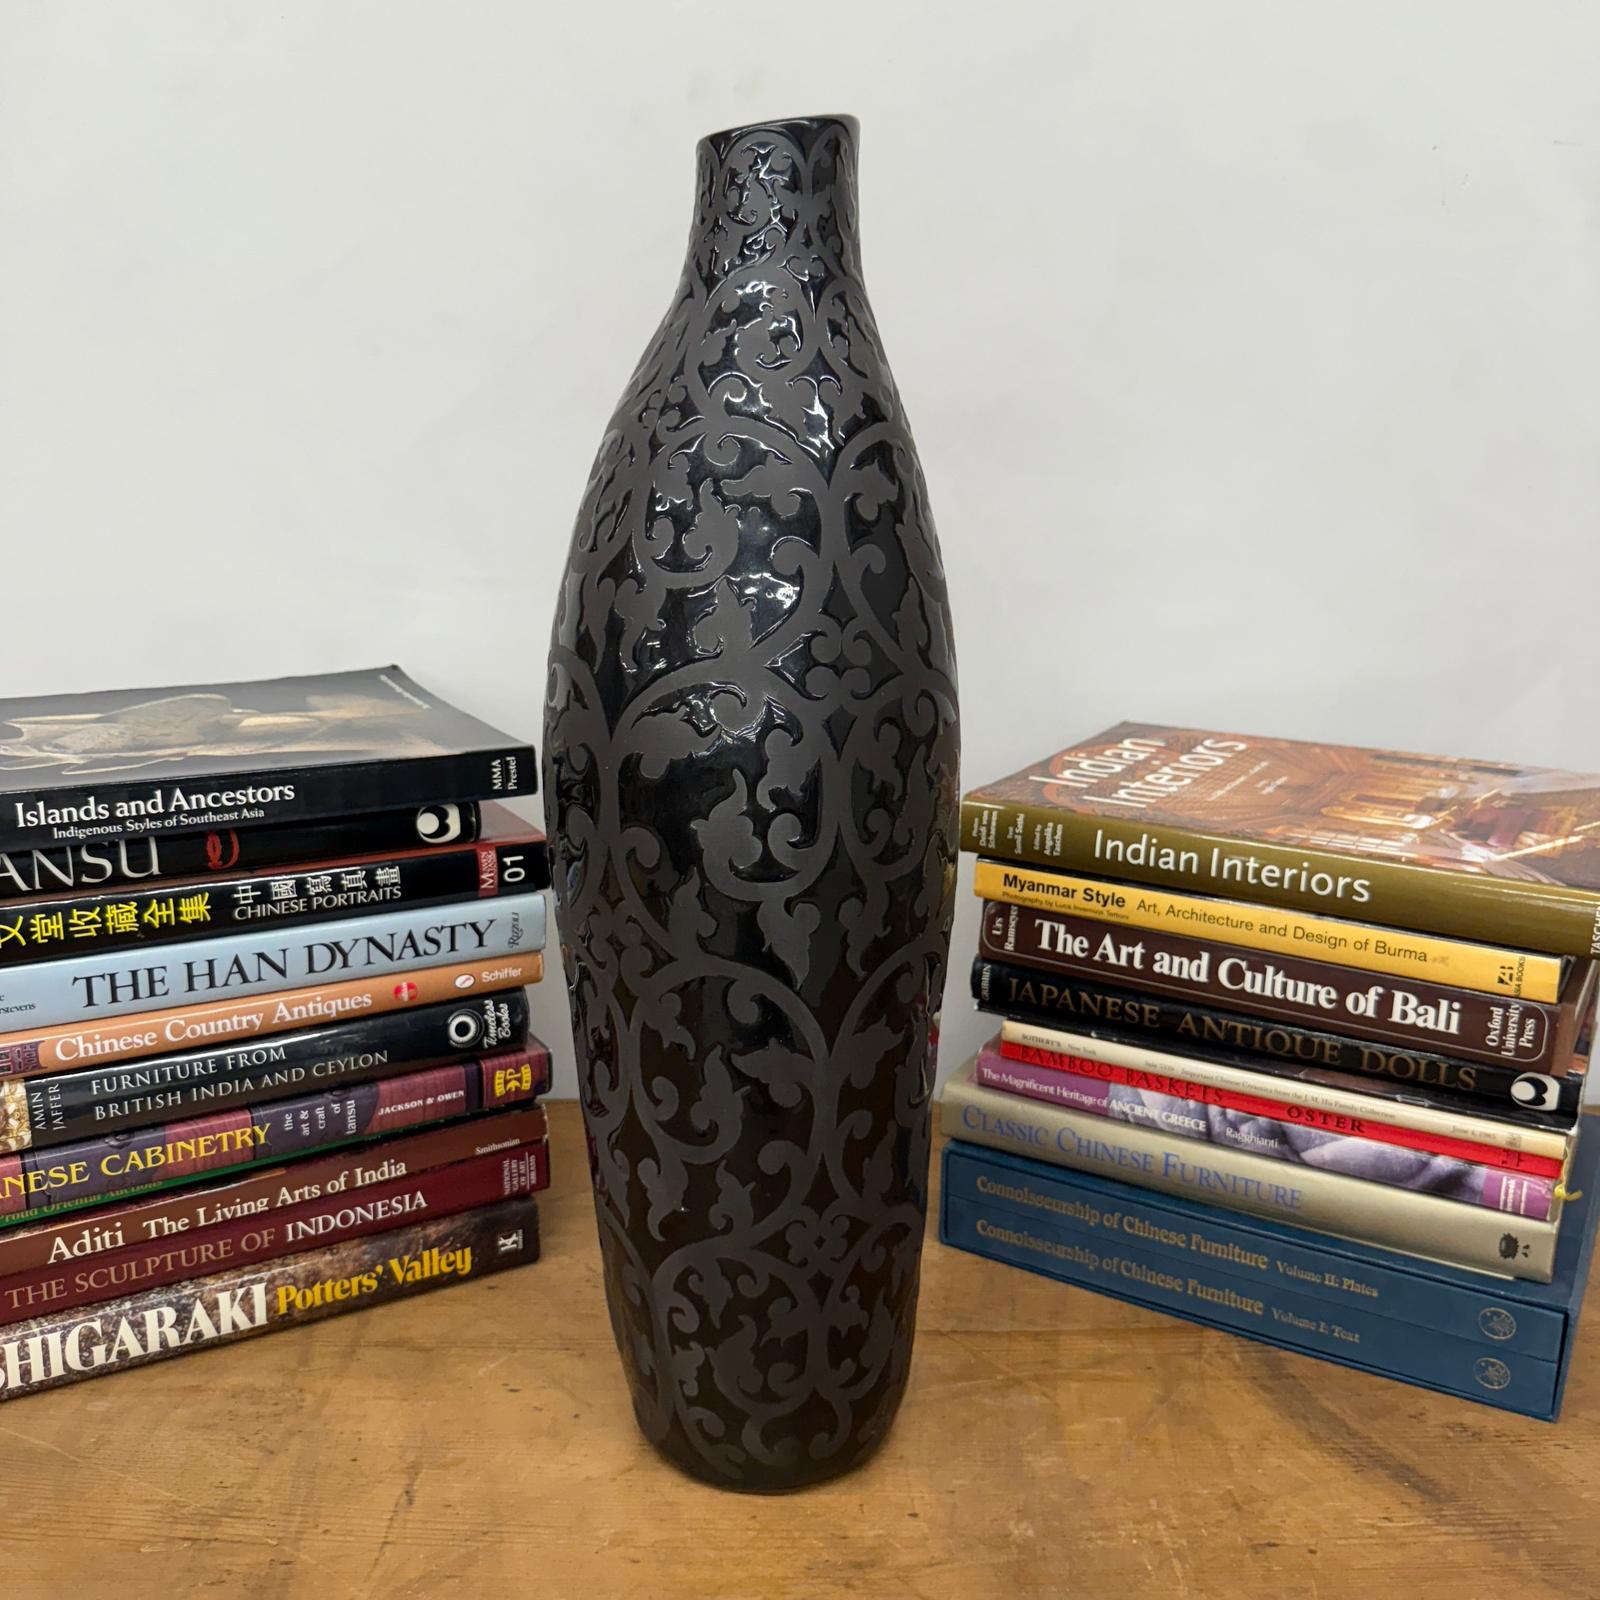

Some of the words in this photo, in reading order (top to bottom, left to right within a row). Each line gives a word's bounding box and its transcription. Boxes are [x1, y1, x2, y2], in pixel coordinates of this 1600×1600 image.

[491, 759, 503, 791] MMA
[507, 756, 518, 791] Prestel
[1028, 736, 1166, 788] Indian
[1083, 738, 1248, 808] Interiors
[15, 796, 110, 828] Islands
[115, 790, 165, 818] and
[168, 784, 295, 813] Ancestors
[53, 824, 123, 840] Indigenous
[126, 818, 163, 836] Styles
[164, 816, 179, 828] of
[180, 810, 239, 827] Southeast
[241, 807, 265, 821] Asia
[503, 855, 526, 883] 01
[1094, 829, 1199, 874] Indian
[1210, 848, 1372, 903] Interiors
[233, 898, 308, 921] CHINESE
[312, 886, 402, 911] PORTRAITS
[992, 917, 1003, 935] Urs
[1003, 873, 1077, 899] Myanmar
[1083, 887, 1126, 908] Style
[1136, 899, 1161, 916] Art,
[1165, 903, 1254, 931] Architecture
[1259, 921, 1288, 937] and
[1293, 926, 1347, 949] Design
[1353, 938, 1370, 952] of
[1374, 940, 1428, 963] Burma
[72, 965, 170, 1008] THE
[184, 948, 290, 993] HAN
[304, 919, 497, 974] DYNASTY
[482, 967, 523, 983] Schiffer
[1035, 918, 1090, 957] The
[1093, 932, 1146, 970] Art
[1153, 951, 1210, 983] and
[1218, 957, 1337, 1009] Culture
[1346, 985, 1383, 1018] of
[1388, 989, 1462, 1035] Bali
[55, 1030, 158, 1062] Chinese
[165, 1012, 264, 1043] Country
[271, 992, 373, 1024] Antiques
[497, 1003, 511, 1040] Books
[1008, 977, 1160, 1028] JAPANESE
[1178, 1012, 1342, 1065] ANTIQUE
[1359, 1047, 1477, 1090] DOLLS
[1485, 1006, 1504, 1048] Oxford
[1501, 1002, 1523, 1057] University
[1518, 1018, 1536, 1048] Press
[90, 1059, 218, 1096] FURNITURE
[226, 1046, 287, 1075] FROM
[94, 1093, 182, 1121] BRITISH
[192, 1078, 255, 1100] INDIA
[261, 1067, 305, 1088] AND
[312, 1050, 389, 1077] CEYLON
[1020, 1046, 1113, 1078] BAMBOO
[1126, 1068, 1223, 1102] BASKETS
[1287, 1105, 1365, 1134] OSTER
[31, 1092, 47, 1131] AMIN
[48, 1083, 67, 1131] JAFFER
[283, 1112, 293, 1131] the
[300, 1110, 310, 1121] &
[315, 1105, 326, 1130] craft
[331, 1102, 342, 1115] of
[378, 1098, 424, 1117] JACKSON
[427, 1096, 435, 1106] &
[437, 1090, 465, 1103] OWEN
[982, 1067, 999, 1081] The
[1001, 1070, 1054, 1096] Magnificent
[1056, 1087, 1096, 1106] Heritage
[1096, 1096, 1108, 1106] of
[1109, 1099, 1160, 1119] ANCIENT
[1161, 1112, 1207, 1132] GREECE
[1225, 1126, 1279, 1149] Ragghianti
[300, 1120, 310, 1136] art
[475, 1138, 521, 1154] Smithsonian
[0, 1161, 91, 1200] NESE
[100, 1123, 272, 1177] CABINETRY
[962, 1103, 1050, 1146] CLASSIC
[1056, 1127, 1154, 1174] CHINESE
[1162, 1151, 1303, 1210] FURNITURE
[47, 1222, 126, 1264] Aditi
[142, 1216, 190, 1239] The
[197, 1198, 269, 1227] Living
[277, 1186, 320, 1208] Arts
[327, 1171, 349, 1194] of
[355, 1159, 407, 1187] India
[5, 1278, 67, 1308] THE
[75, 1240, 234, 1292] SCULPTURE
[240, 1228, 275, 1253] OF
[286, 1191, 428, 1242] INDONESIA
[976, 1175, 1100, 1227] Connoisseurship
[1103, 1211, 1122, 1229] of
[1123, 1216, 1186, 1249] Chinese
[1191, 1233, 1269, 1270] Furniture
[1276, 1260, 1322, 1284] Volume
[1342, 1277, 1379, 1298] Plates
[390, 1247, 471, 1284] Valley
[976, 1219, 1100, 1271] Connoisseurship
[1102, 1256, 1121, 1273] of
[1120, 1259, 1183, 1293] Chinese
[1187, 1278, 1264, 1316] Furniture
[1271, 1307, 1316, 1331] Volume
[1332, 1324, 1361, 1344] Text
